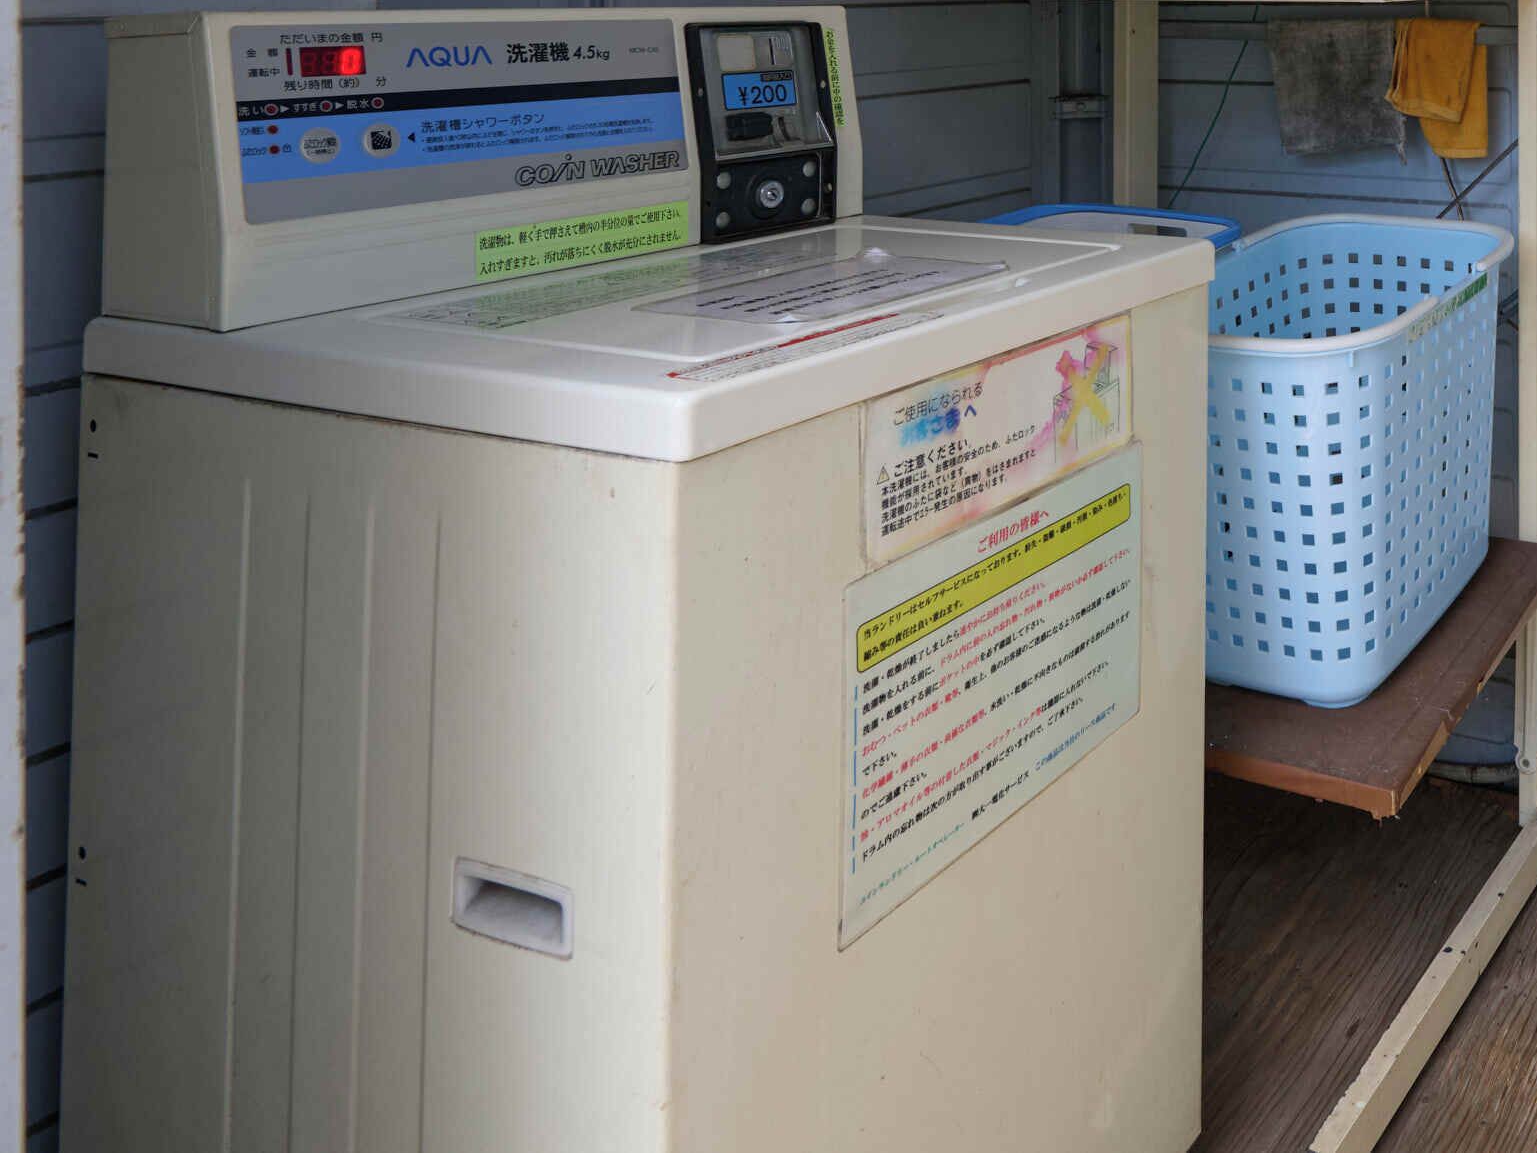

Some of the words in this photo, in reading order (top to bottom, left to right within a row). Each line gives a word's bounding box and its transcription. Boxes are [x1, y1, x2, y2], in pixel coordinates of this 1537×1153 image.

[279, 32, 364, 46] ただいまの金額
[371, 31, 383, 43] 円
[405, 46, 493, 68] AQUA
[506, 42, 570, 64] 洗濯機
[375, 76, 387, 88] 分
[737, 83, 787, 107] ¥200
[420, 113, 545, 134] 洗濯槽シャワーボタン
[590, 149, 681, 178] WASHER
